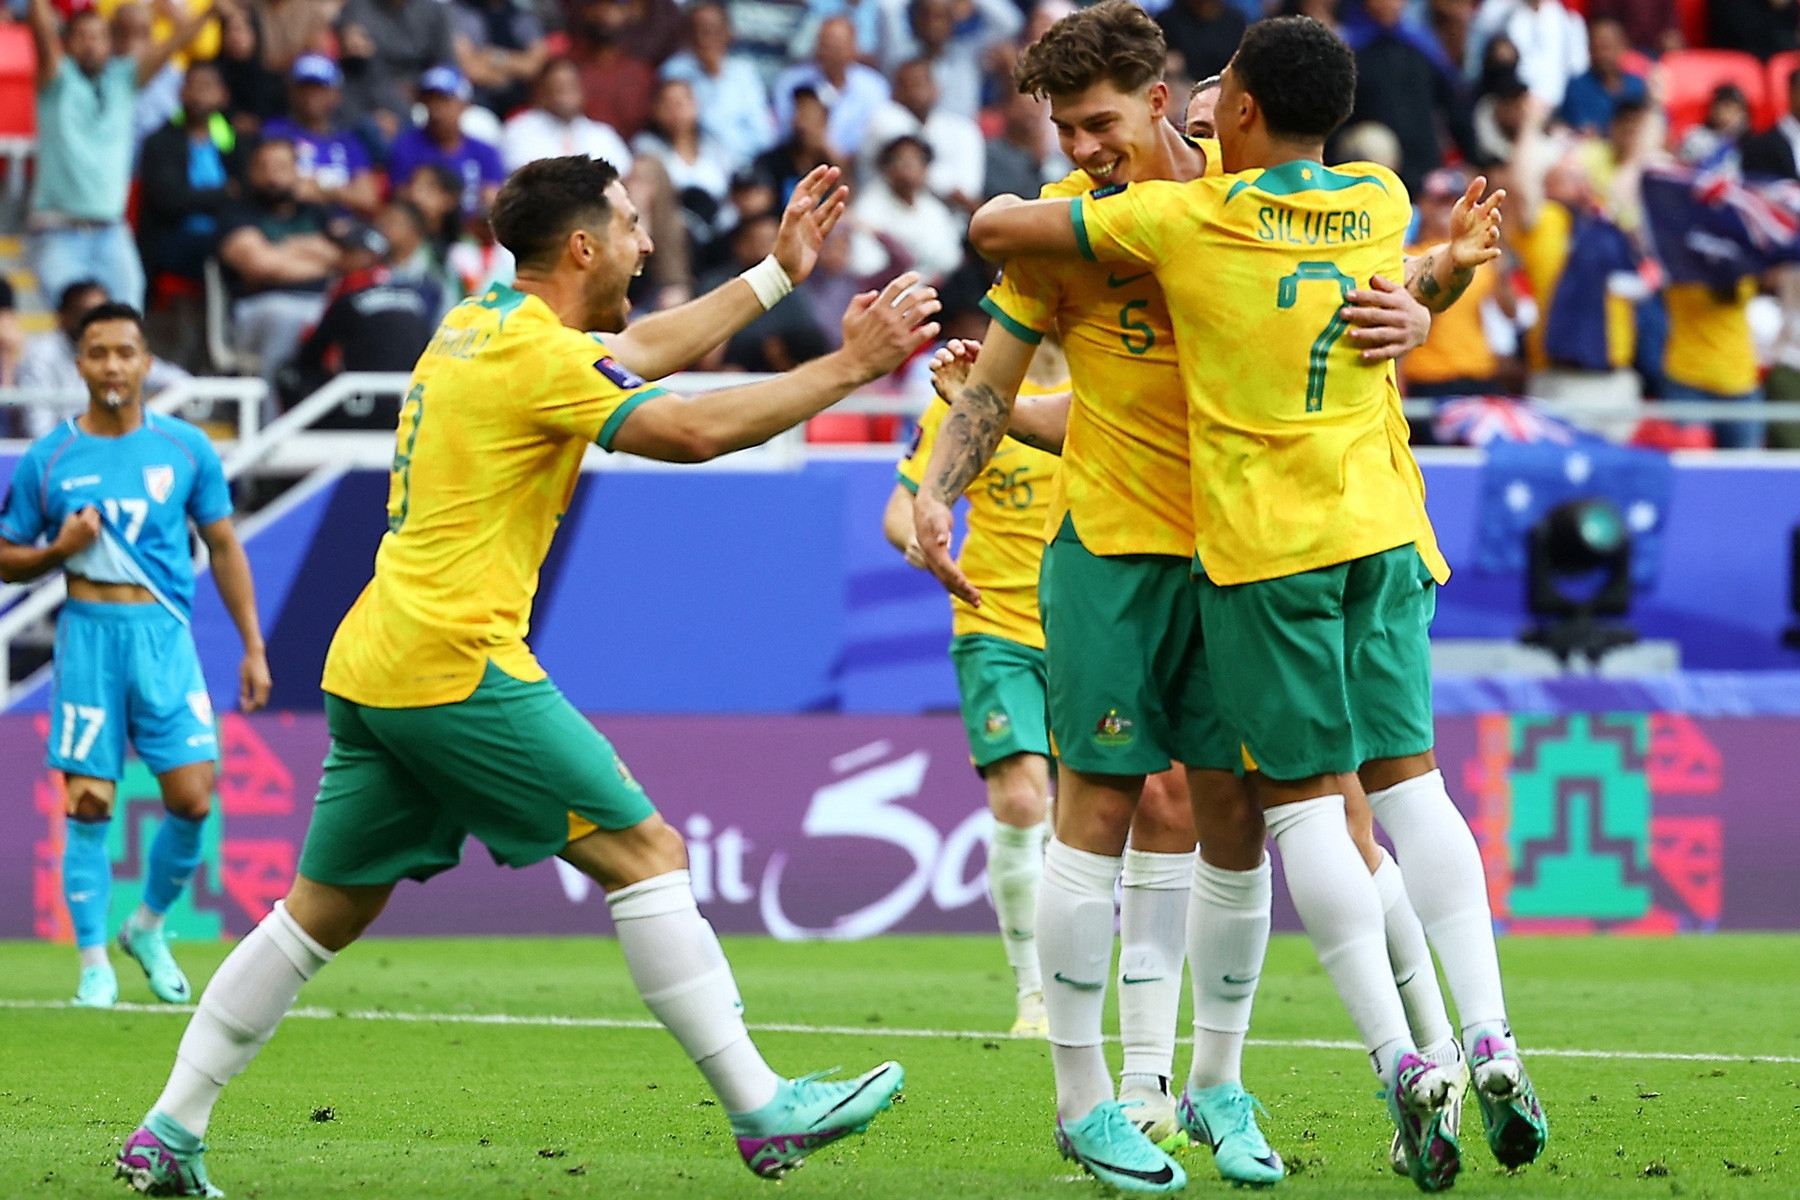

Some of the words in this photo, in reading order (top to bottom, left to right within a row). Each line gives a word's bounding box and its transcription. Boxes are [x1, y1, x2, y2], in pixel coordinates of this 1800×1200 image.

[1258, 207, 1371, 244] SILVERA
[1119, 299, 1155, 354] 5
[1277, 261, 1358, 412] 7
[987, 467, 1033, 510] 26
[104, 498, 148, 546] 17
[60, 702, 106, 762] 17
